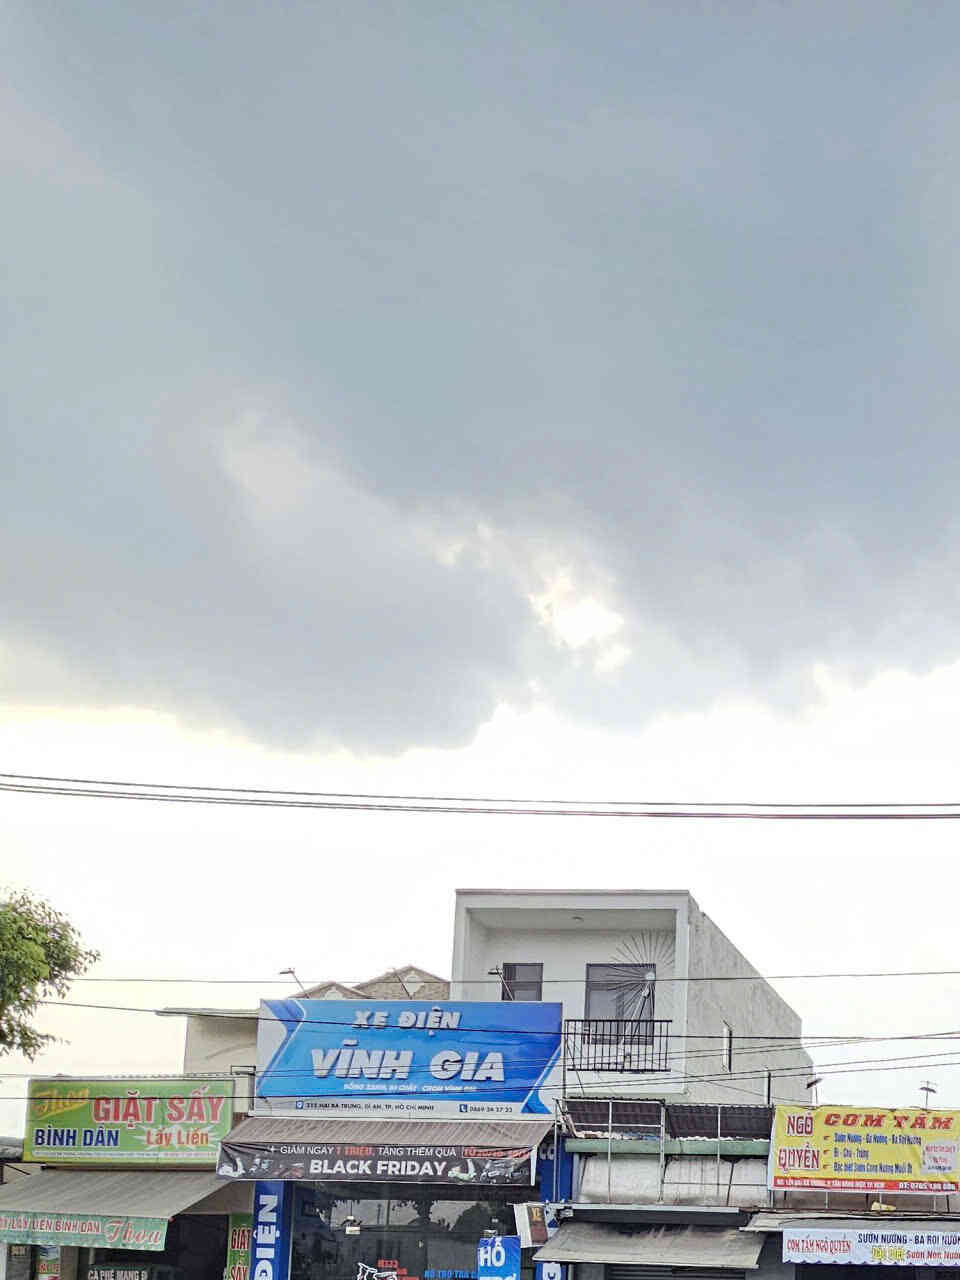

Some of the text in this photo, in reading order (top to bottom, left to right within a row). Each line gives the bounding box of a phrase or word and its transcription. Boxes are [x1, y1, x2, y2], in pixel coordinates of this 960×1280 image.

[352, 1006, 461, 1037] XE ĐIỆN
[311, 1039, 505, 1082] VĨNH GIA
[93, 1089, 158, 1129] GIẶT
[167, 1084, 225, 1124] SẤY
[34, 1125, 77, 1147] BÌNH
[82, 1125, 120, 1147] DÂN
[306, 1145, 334, 1155] NGAY
[309, 1159, 447, 1176] BLACK FRIDAY
[479, 1236, 506, 1267] HỖ
